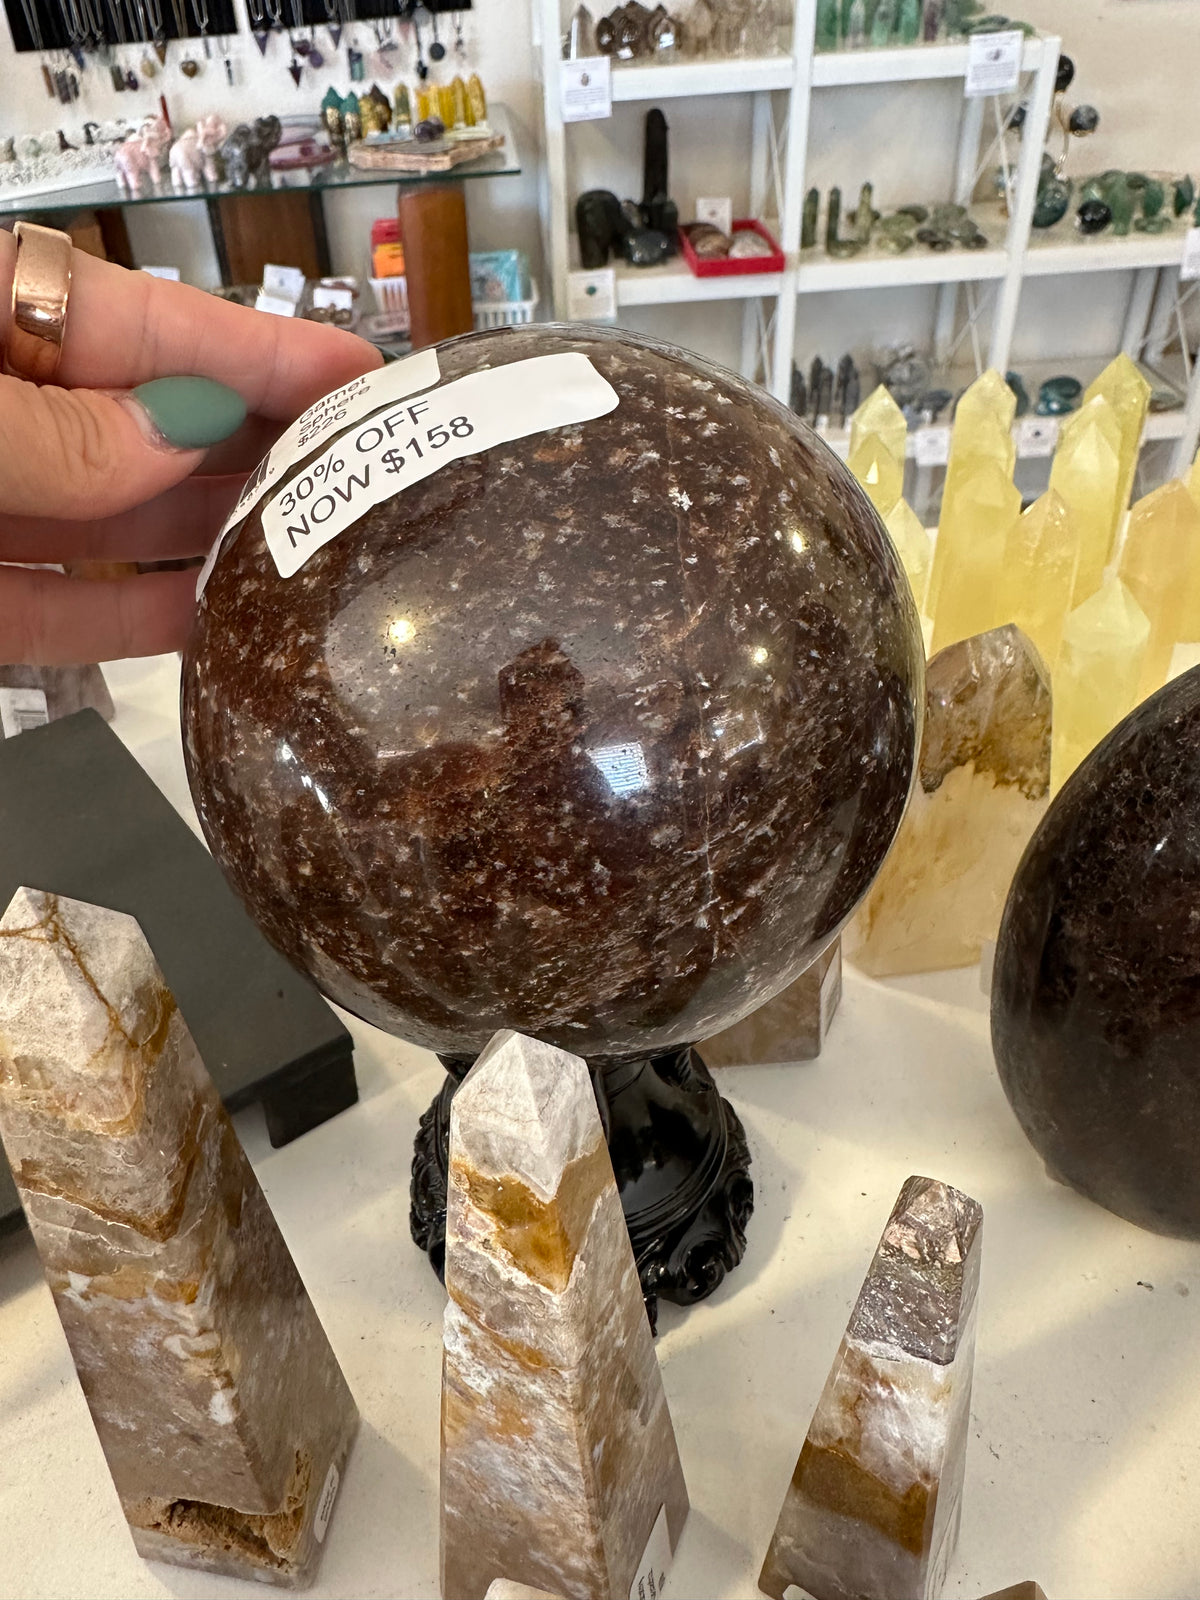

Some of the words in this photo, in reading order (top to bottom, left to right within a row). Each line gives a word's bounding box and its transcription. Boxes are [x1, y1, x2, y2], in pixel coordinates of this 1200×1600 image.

[299, 376, 367, 424] Garnet
[299, 385, 370, 436] Sphere
[298, 408, 347, 448] $226
[279, 453, 344, 516] 30%
[357, 400, 430, 452] OFF
[286, 464, 370, 548] NOW
[381, 416, 475, 474] $158
